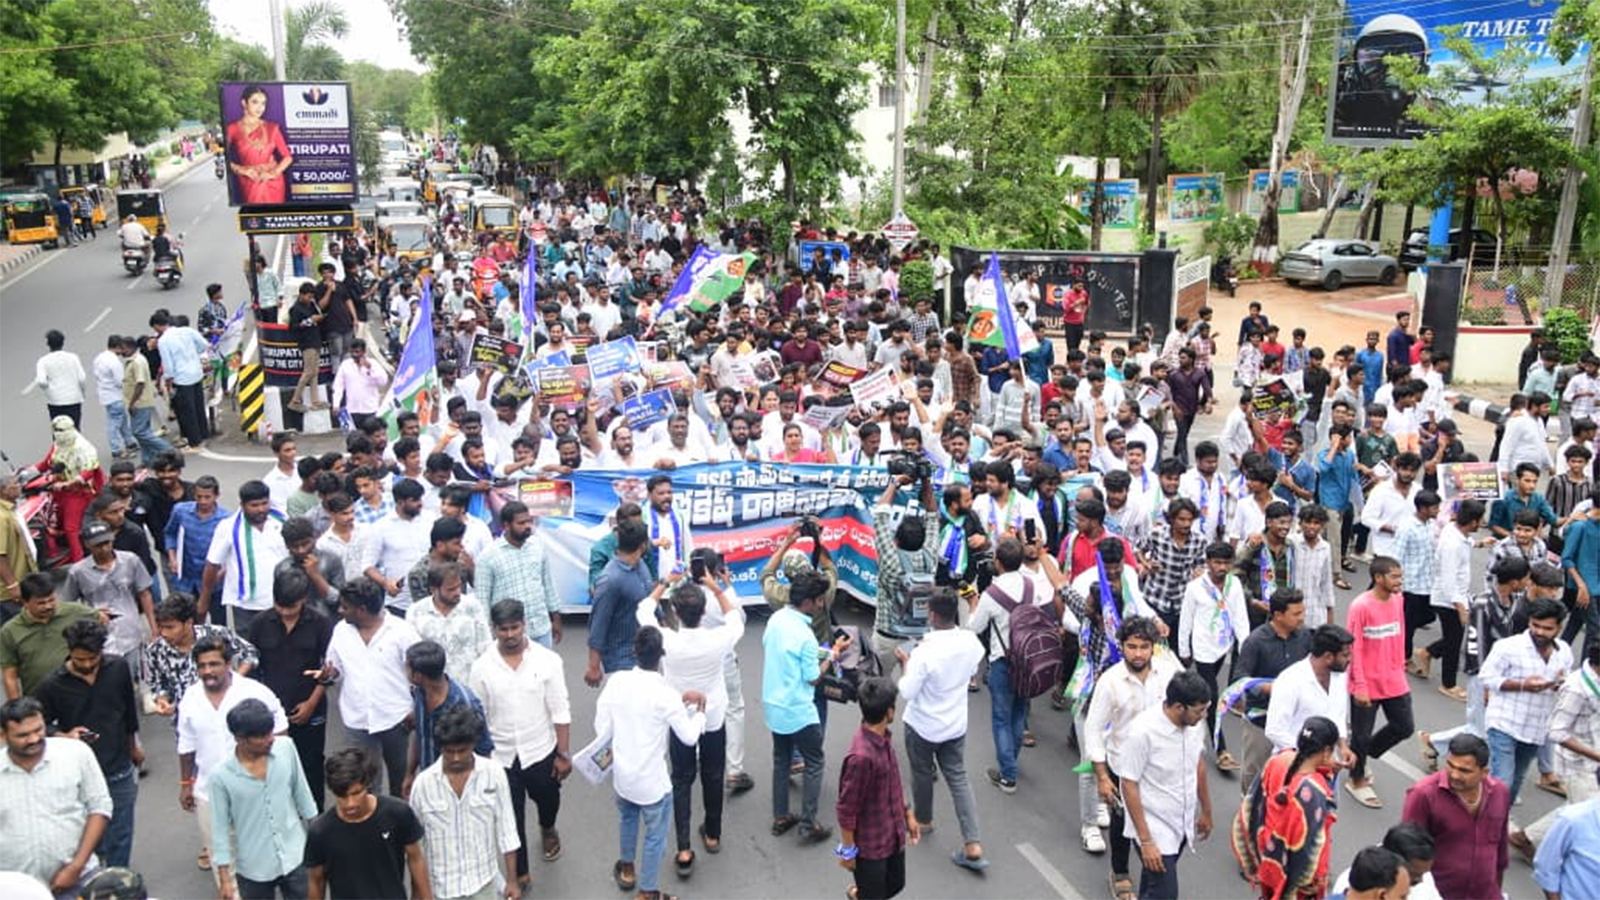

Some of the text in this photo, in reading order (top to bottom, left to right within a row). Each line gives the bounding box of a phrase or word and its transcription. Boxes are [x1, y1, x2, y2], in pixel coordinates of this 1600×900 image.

[1463, 20, 1529, 38] TAME
[287, 143, 351, 155] TIRUPATI
[303, 169, 351, 183] 50,000/-
[264, 215, 329, 223] TIRUPATI
[300, 220, 330, 228] POLICE
